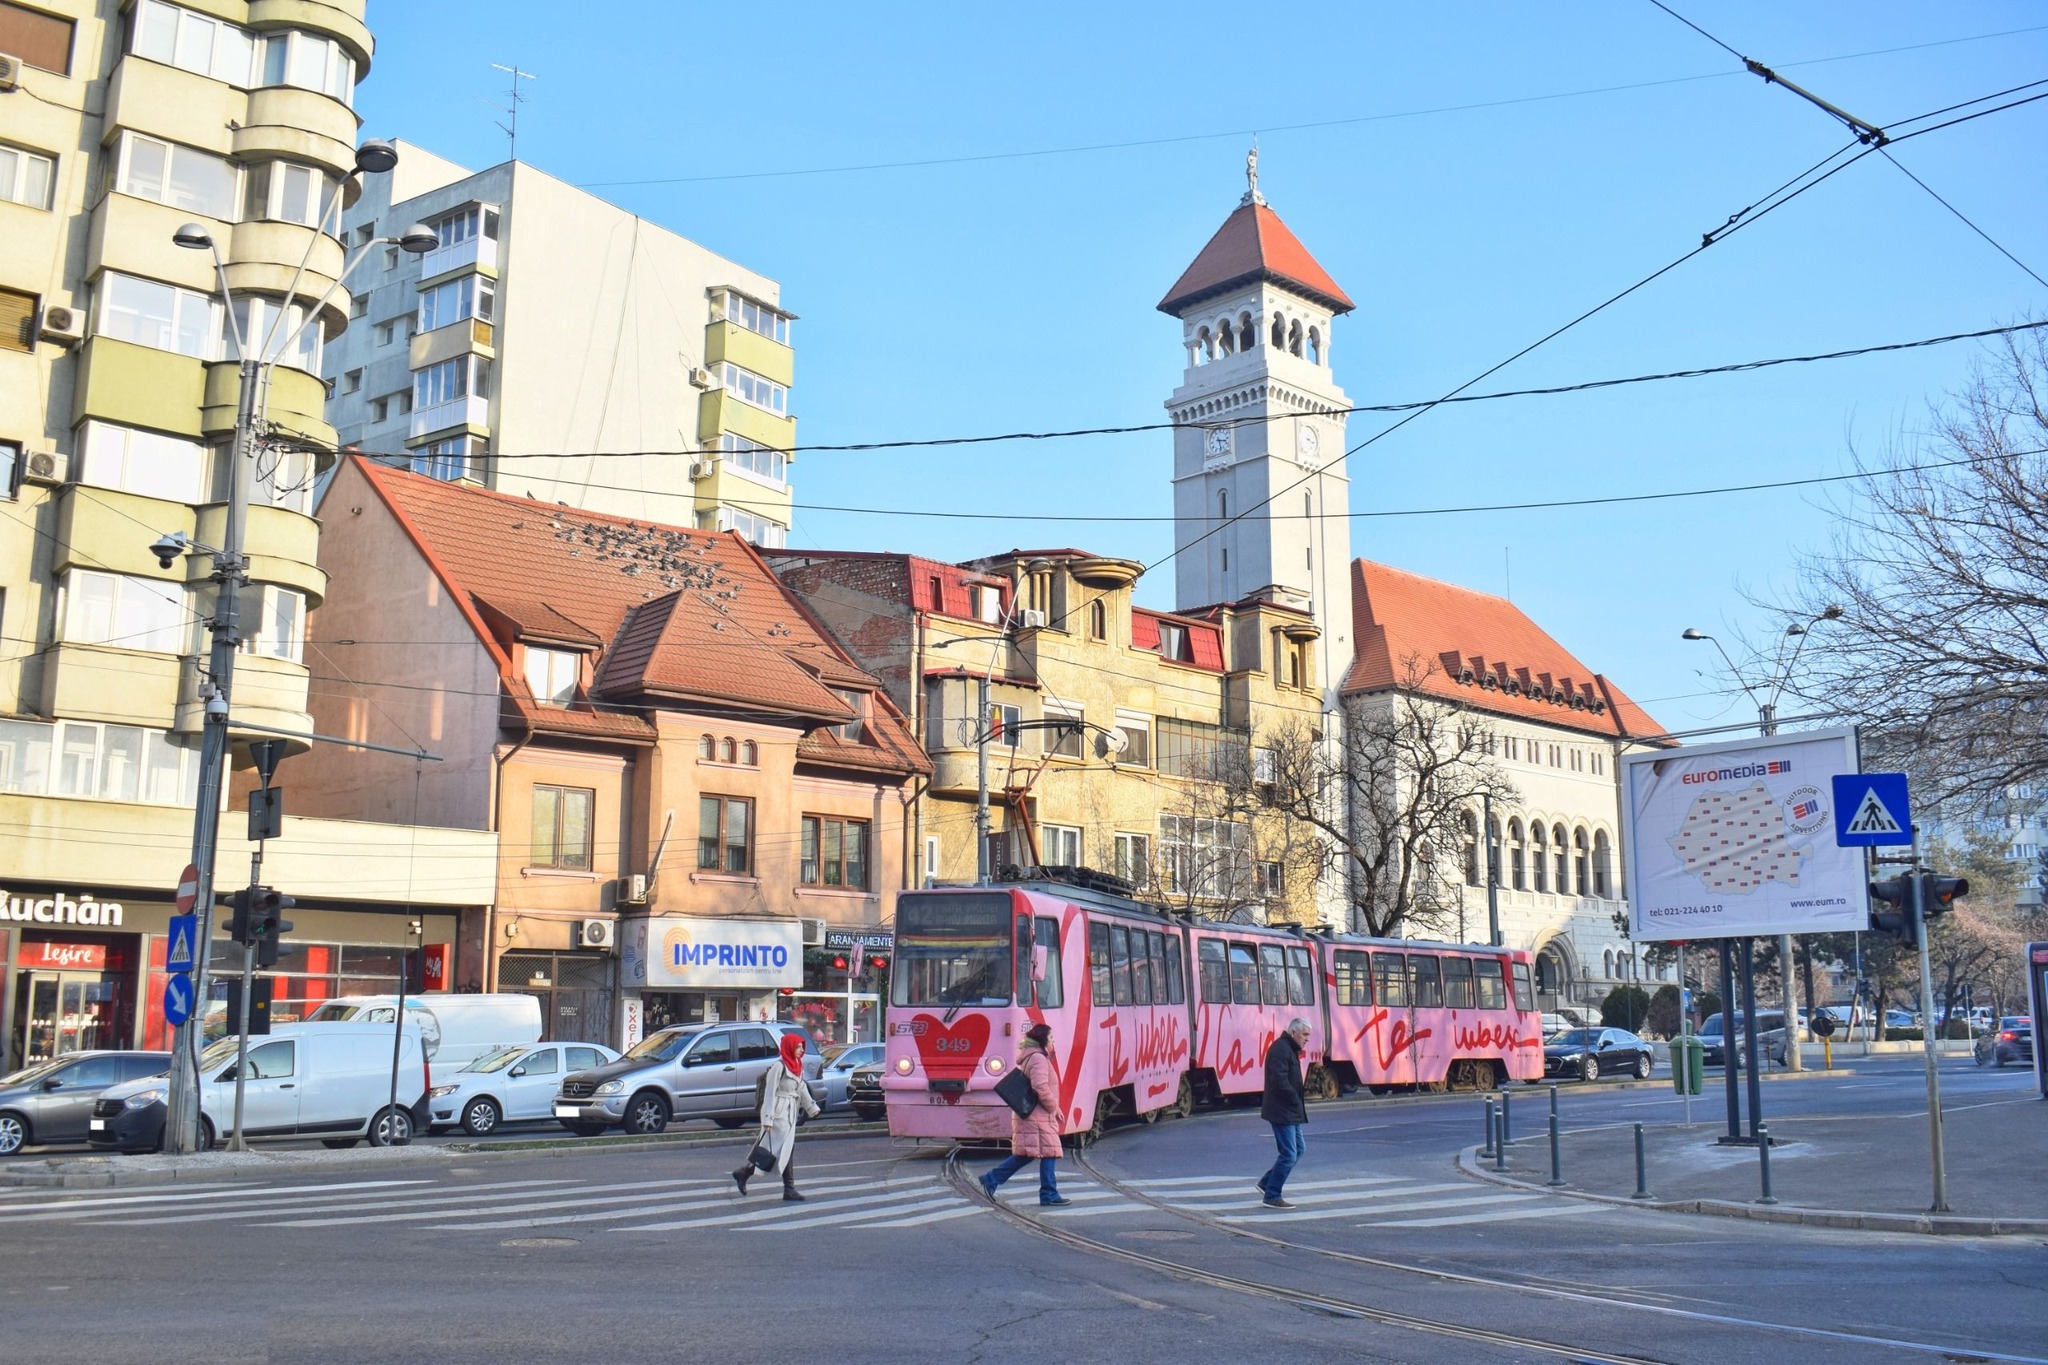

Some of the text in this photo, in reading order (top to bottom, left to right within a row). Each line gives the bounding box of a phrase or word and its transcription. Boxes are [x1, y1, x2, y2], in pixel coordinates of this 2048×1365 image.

[1786, 787, 1818, 806] OUTDOOR
[1790, 810, 1828, 834] ADVERTISING
[1664, 906, 1698, 916] 021-224
[1700, 905, 1711, 914] 40
[1712, 904, 1723, 913] 10
[1790, 897, 1847, 909] www.eum.ro
[830, 934, 893, 947] ARANJAMENTE
[674, 943, 788, 967] IMPRINTO
[936, 1038, 970, 1052] 349
